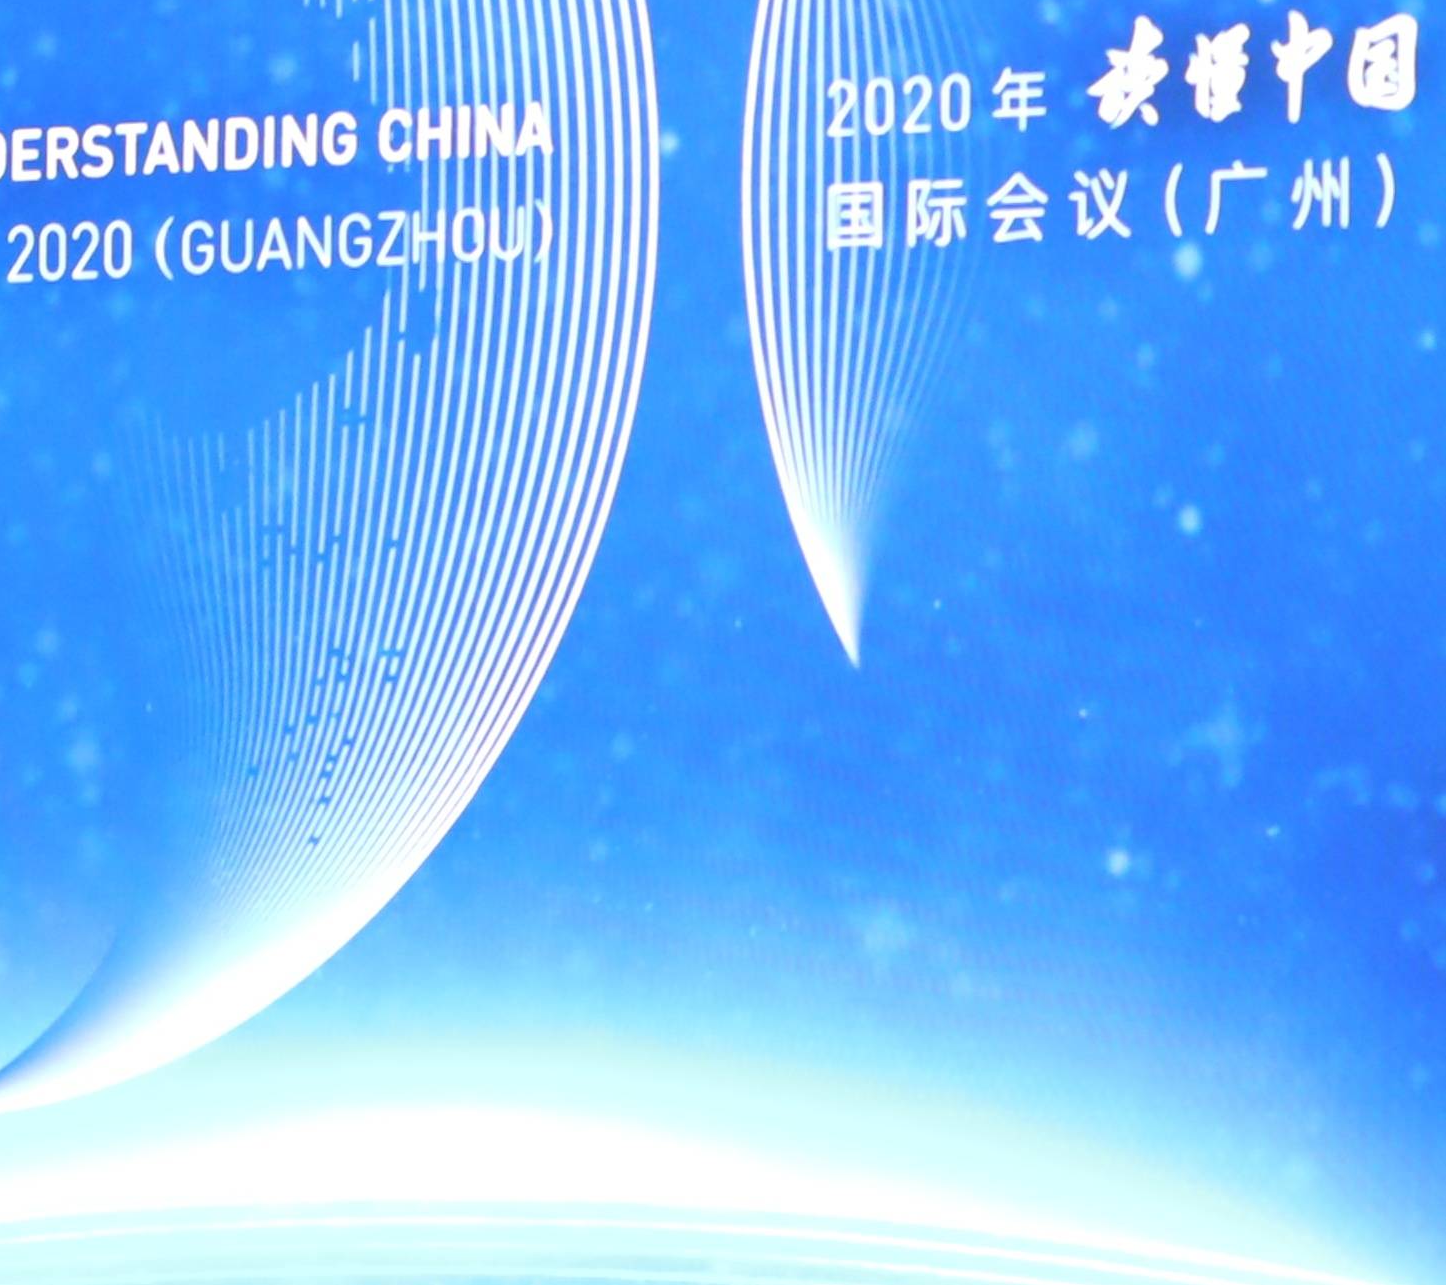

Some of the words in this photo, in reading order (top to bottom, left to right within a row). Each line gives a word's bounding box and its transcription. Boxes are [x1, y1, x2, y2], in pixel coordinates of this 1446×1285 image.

[376, 100, 554, 165] CHINA
[5, 219, 134, 284] 2020
[153, 197, 554, 281] (GUANGZHOU)
